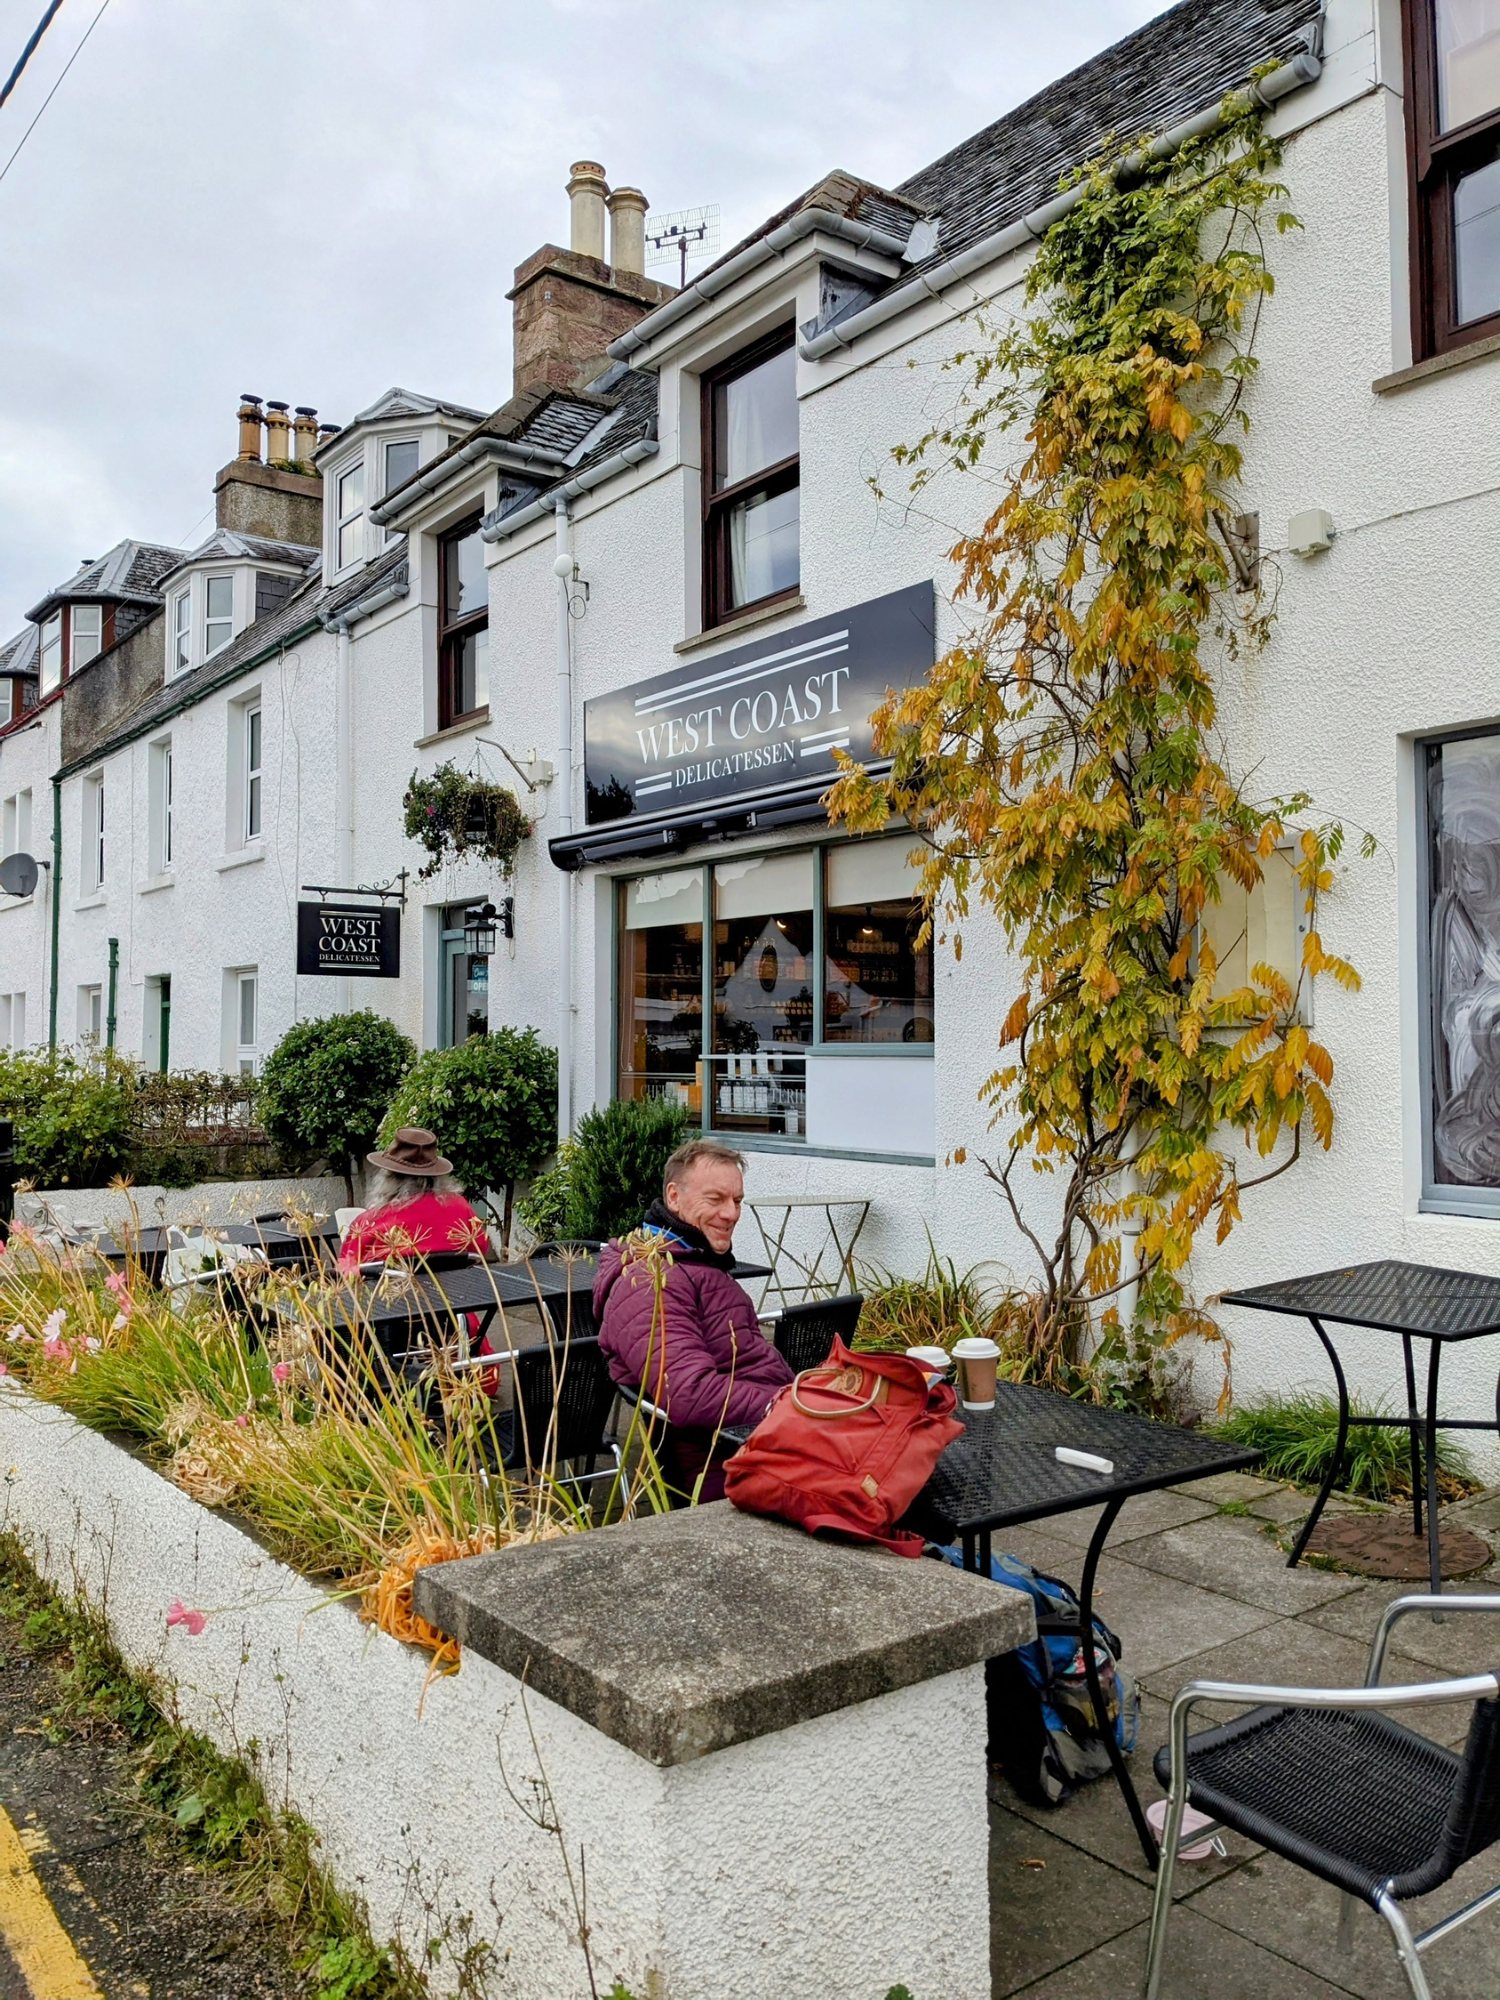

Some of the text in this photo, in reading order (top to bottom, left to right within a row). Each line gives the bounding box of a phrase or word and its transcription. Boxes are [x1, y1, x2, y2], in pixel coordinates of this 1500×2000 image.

[635, 666, 850, 765] WEST COAST
[675, 739, 796, 788] DELICATESSEN
[320, 917, 381, 936] WEST
[319, 936, 381, 953] COAST
[319, 953, 380, 962] DELICATESSEN
[473, 981, 488, 992] OPE
